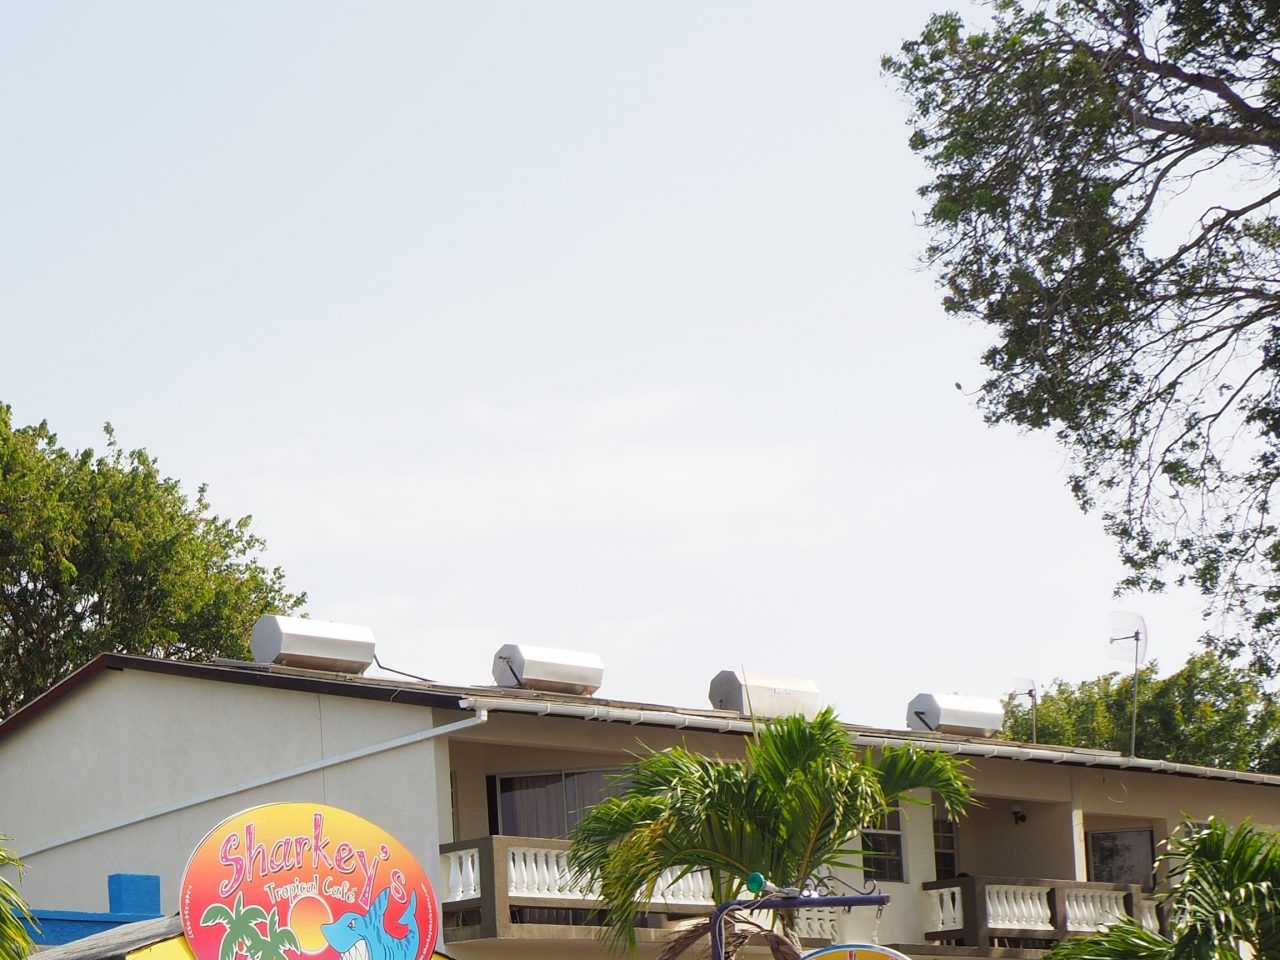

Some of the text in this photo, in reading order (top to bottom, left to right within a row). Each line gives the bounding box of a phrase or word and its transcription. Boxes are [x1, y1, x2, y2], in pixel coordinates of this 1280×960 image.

[219, 812, 408, 909] Sharkey's
[264, 874, 356, 905] Tropical Café
